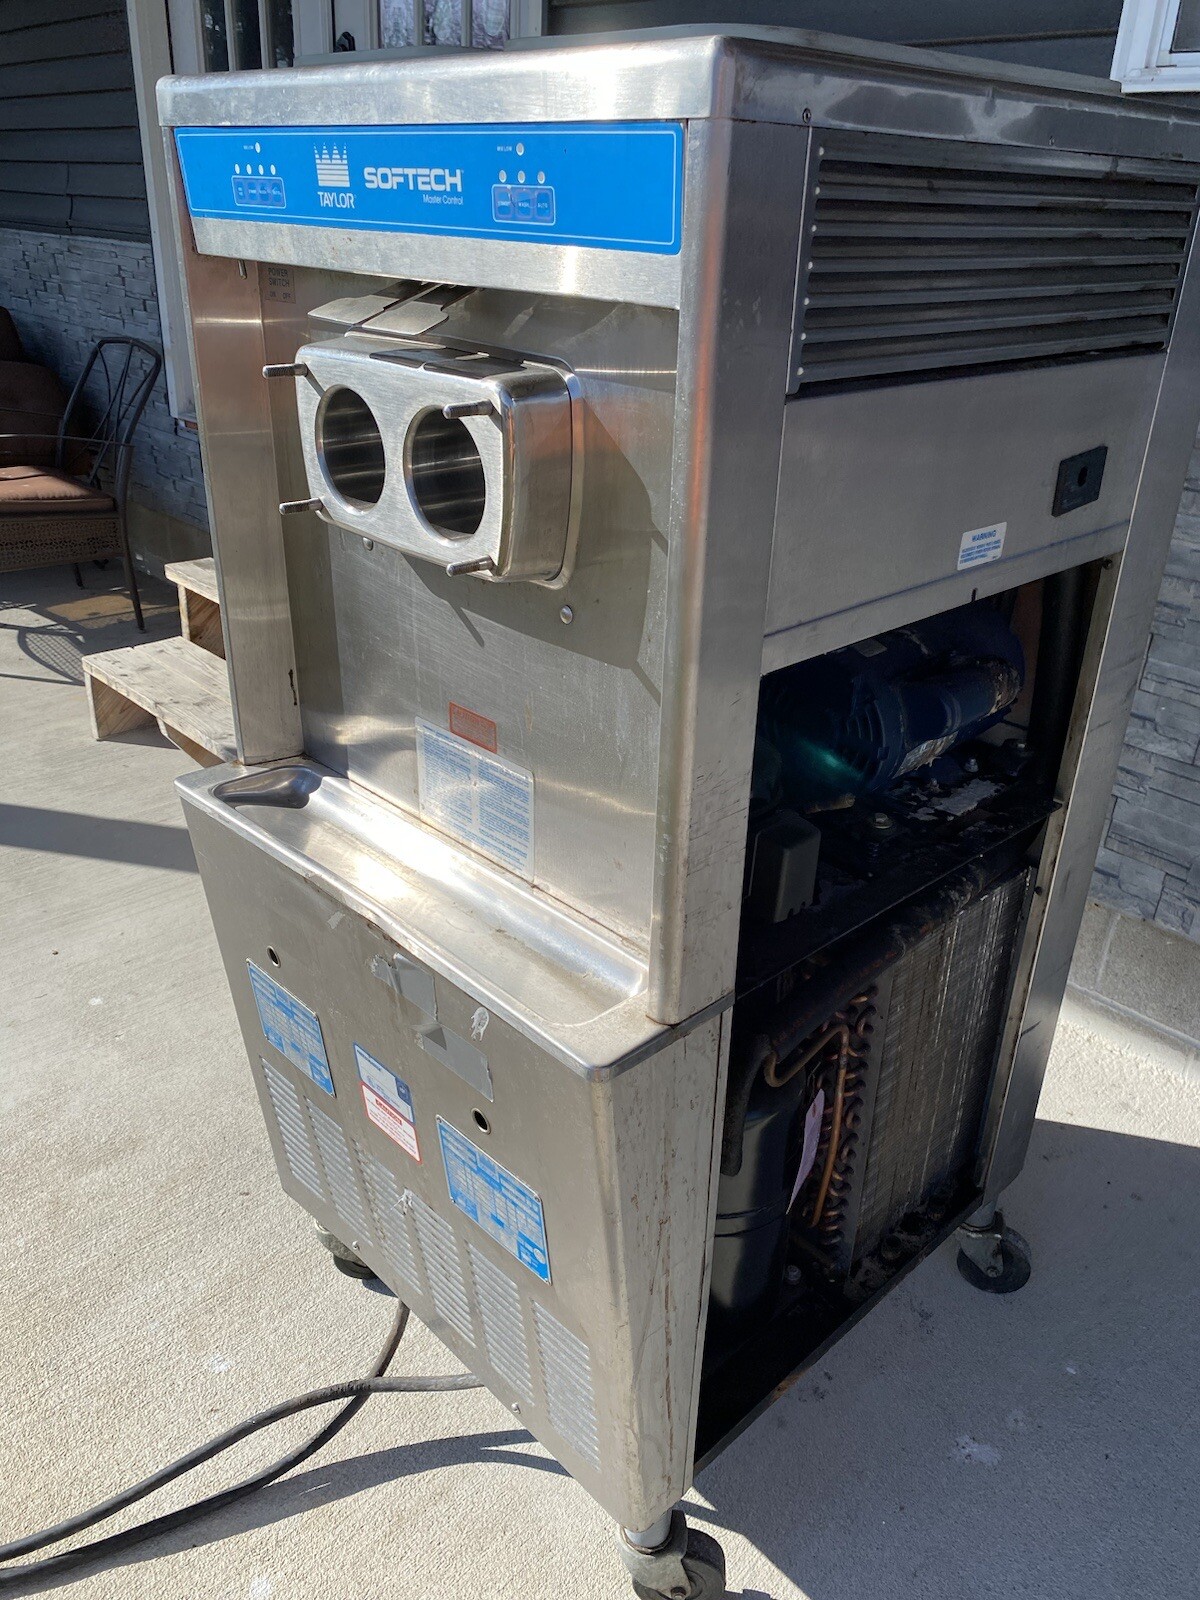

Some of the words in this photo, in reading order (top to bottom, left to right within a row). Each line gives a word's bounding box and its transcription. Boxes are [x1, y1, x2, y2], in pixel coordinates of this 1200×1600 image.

[364, 167, 462, 192] SOFTECH
[317, 191, 355, 209] TAYLOR
[423, 194, 441, 204] Master
[442, 195, 463, 205] Control
[268, 267, 288, 277] POWER
[269, 277, 290, 288] SWITCH
